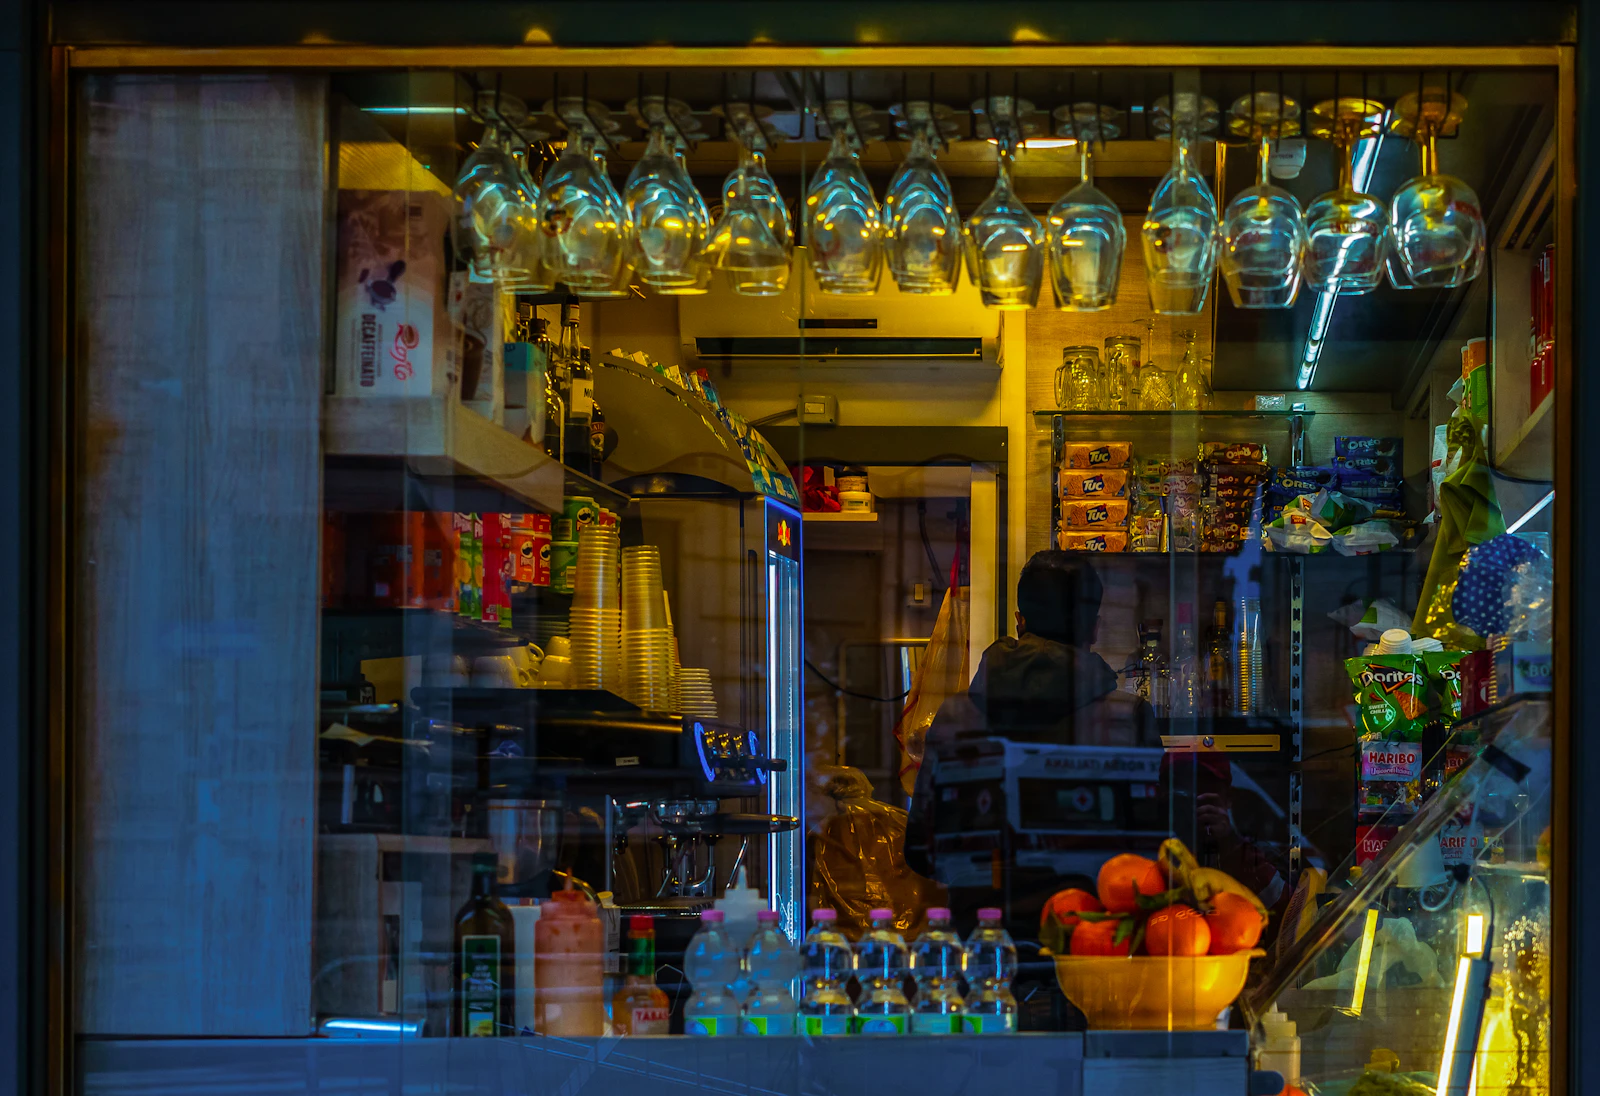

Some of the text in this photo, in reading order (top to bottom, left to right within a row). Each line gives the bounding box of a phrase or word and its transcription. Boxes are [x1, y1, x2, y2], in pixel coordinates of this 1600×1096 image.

[360, 314, 376, 388] DECAFFEINATO
[1347, 438, 1381, 450] OREO
[1089, 450, 1109, 463] TUC
[1344, 457, 1378, 469] OREO
[1083, 479, 1104, 492] TUC
[1281, 478, 1316, 490] OREO
[1087, 509, 1107, 521] TUC
[1085, 540, 1106, 552] TUC
[1361, 670, 1424, 687] Doritos
[1369, 752, 1415, 764] HARIBO
